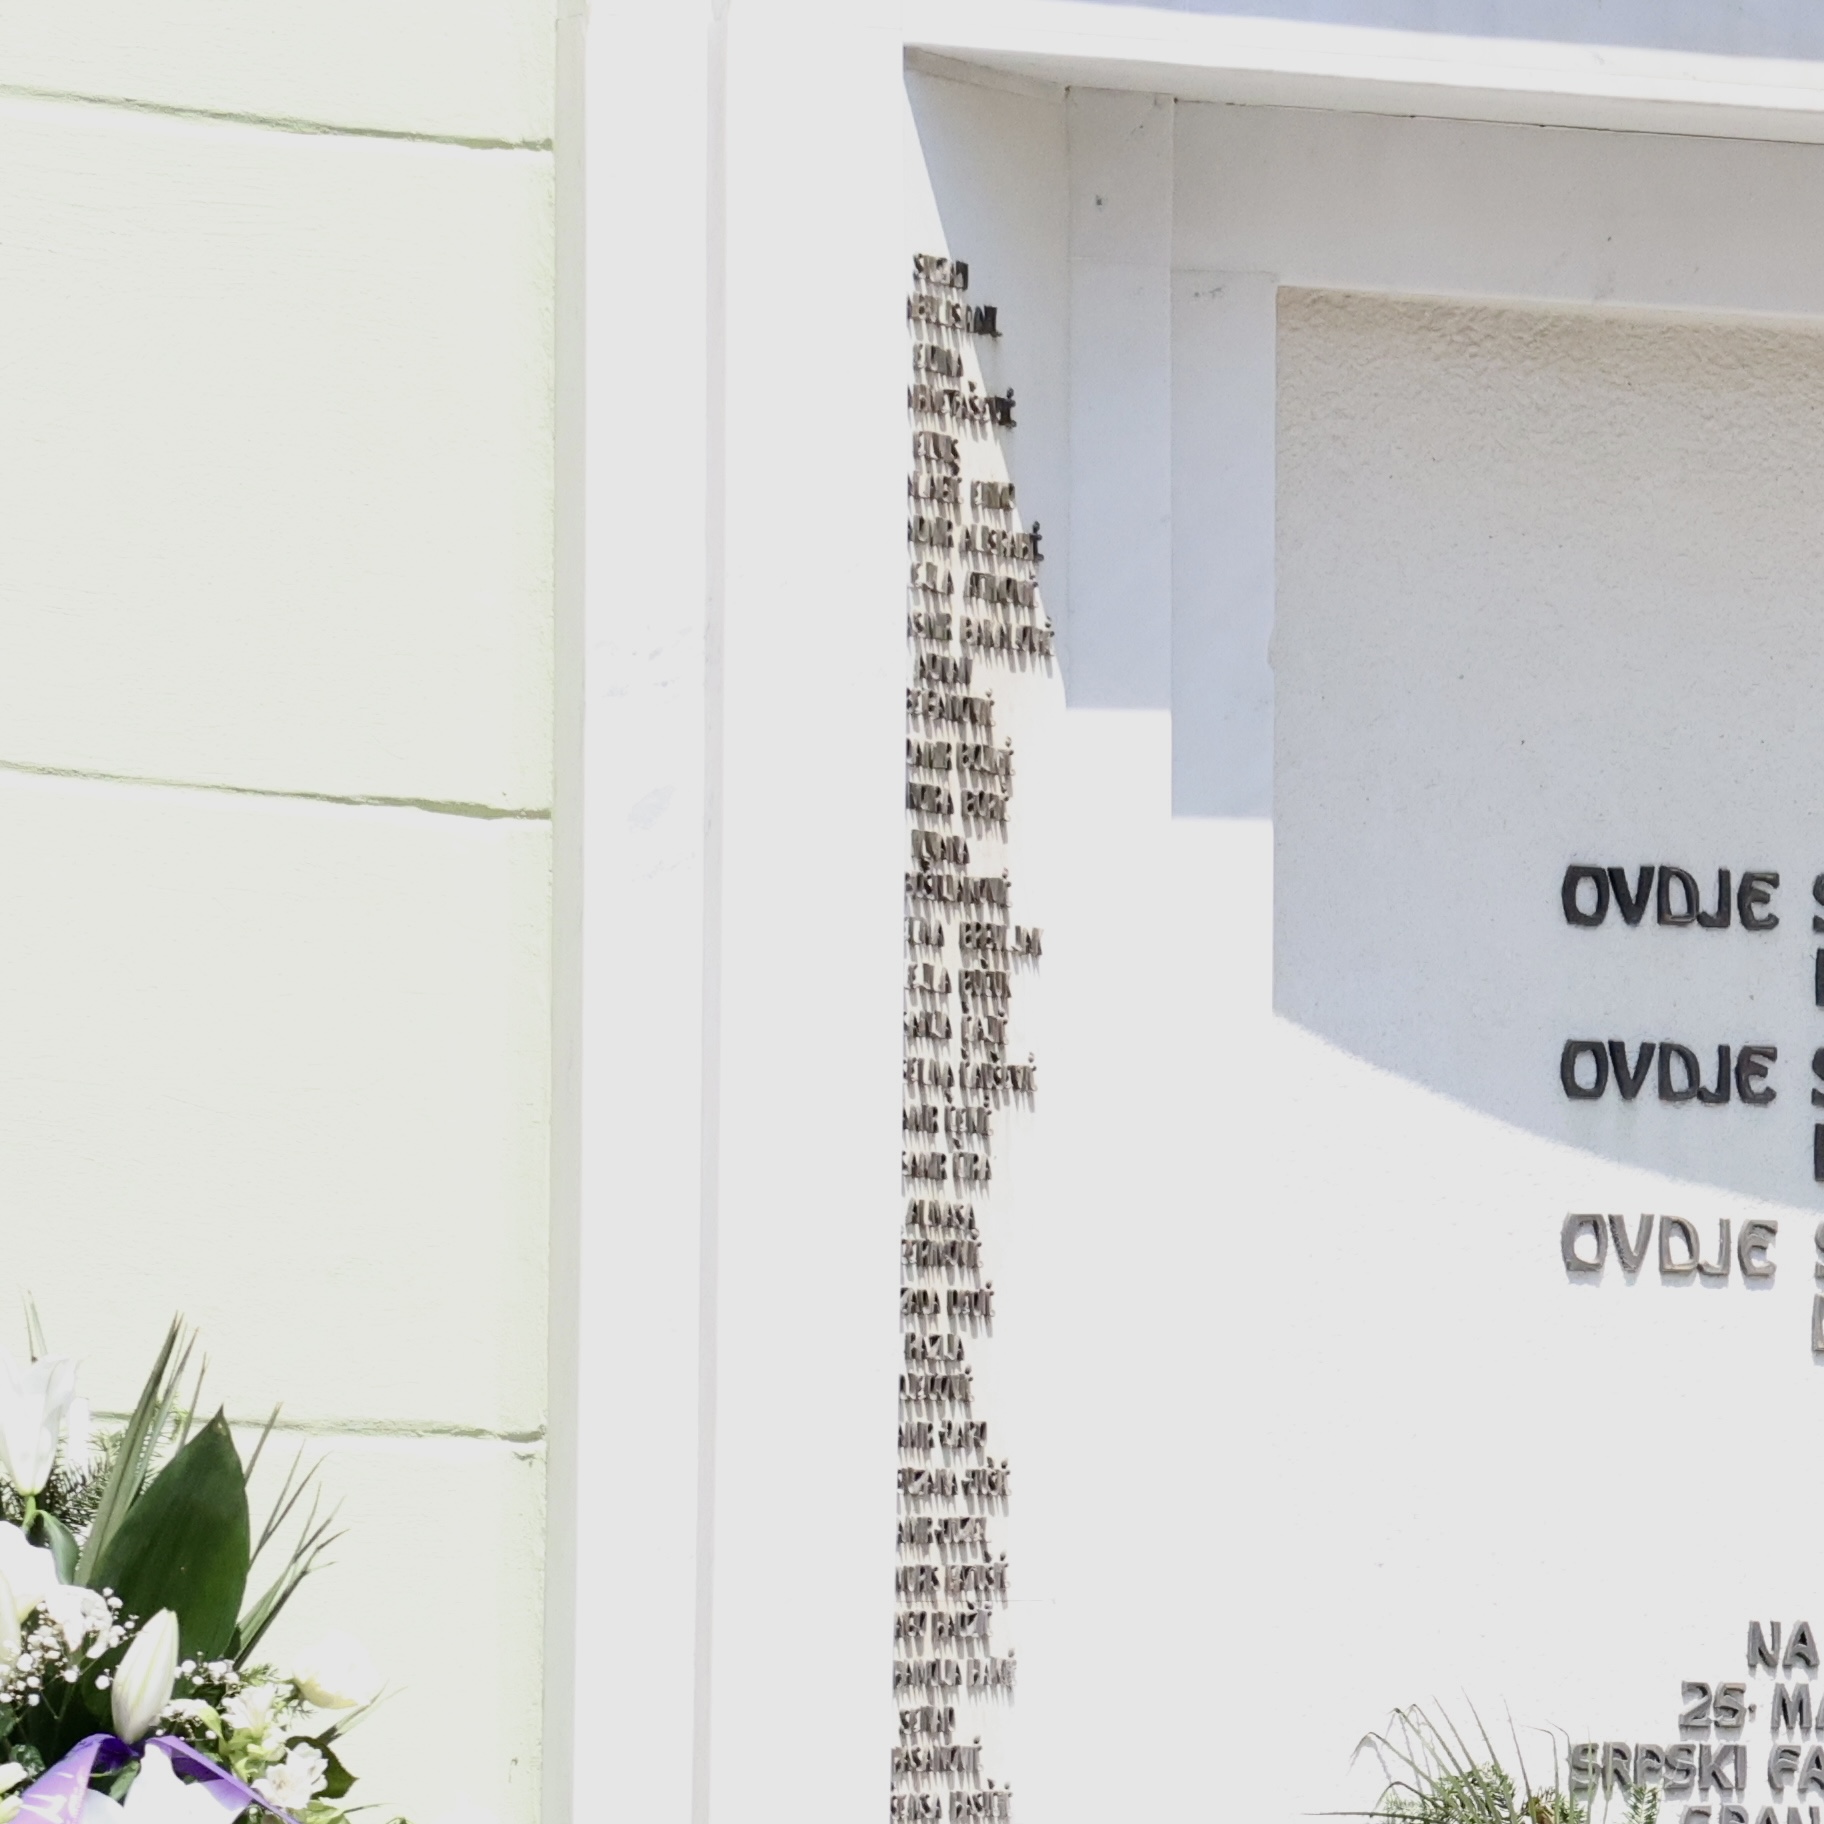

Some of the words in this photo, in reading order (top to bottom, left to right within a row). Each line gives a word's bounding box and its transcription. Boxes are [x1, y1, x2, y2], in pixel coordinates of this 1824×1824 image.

[1563, 865, 1780, 931] OVDJE
[1561, 1039, 1778, 1105] OVDJE
[1561, 1212, 1778, 1280] OVDJE
[1746, 1620, 1820, 1668] NA
[1570, 1742, 1748, 1792] SRPSKI
